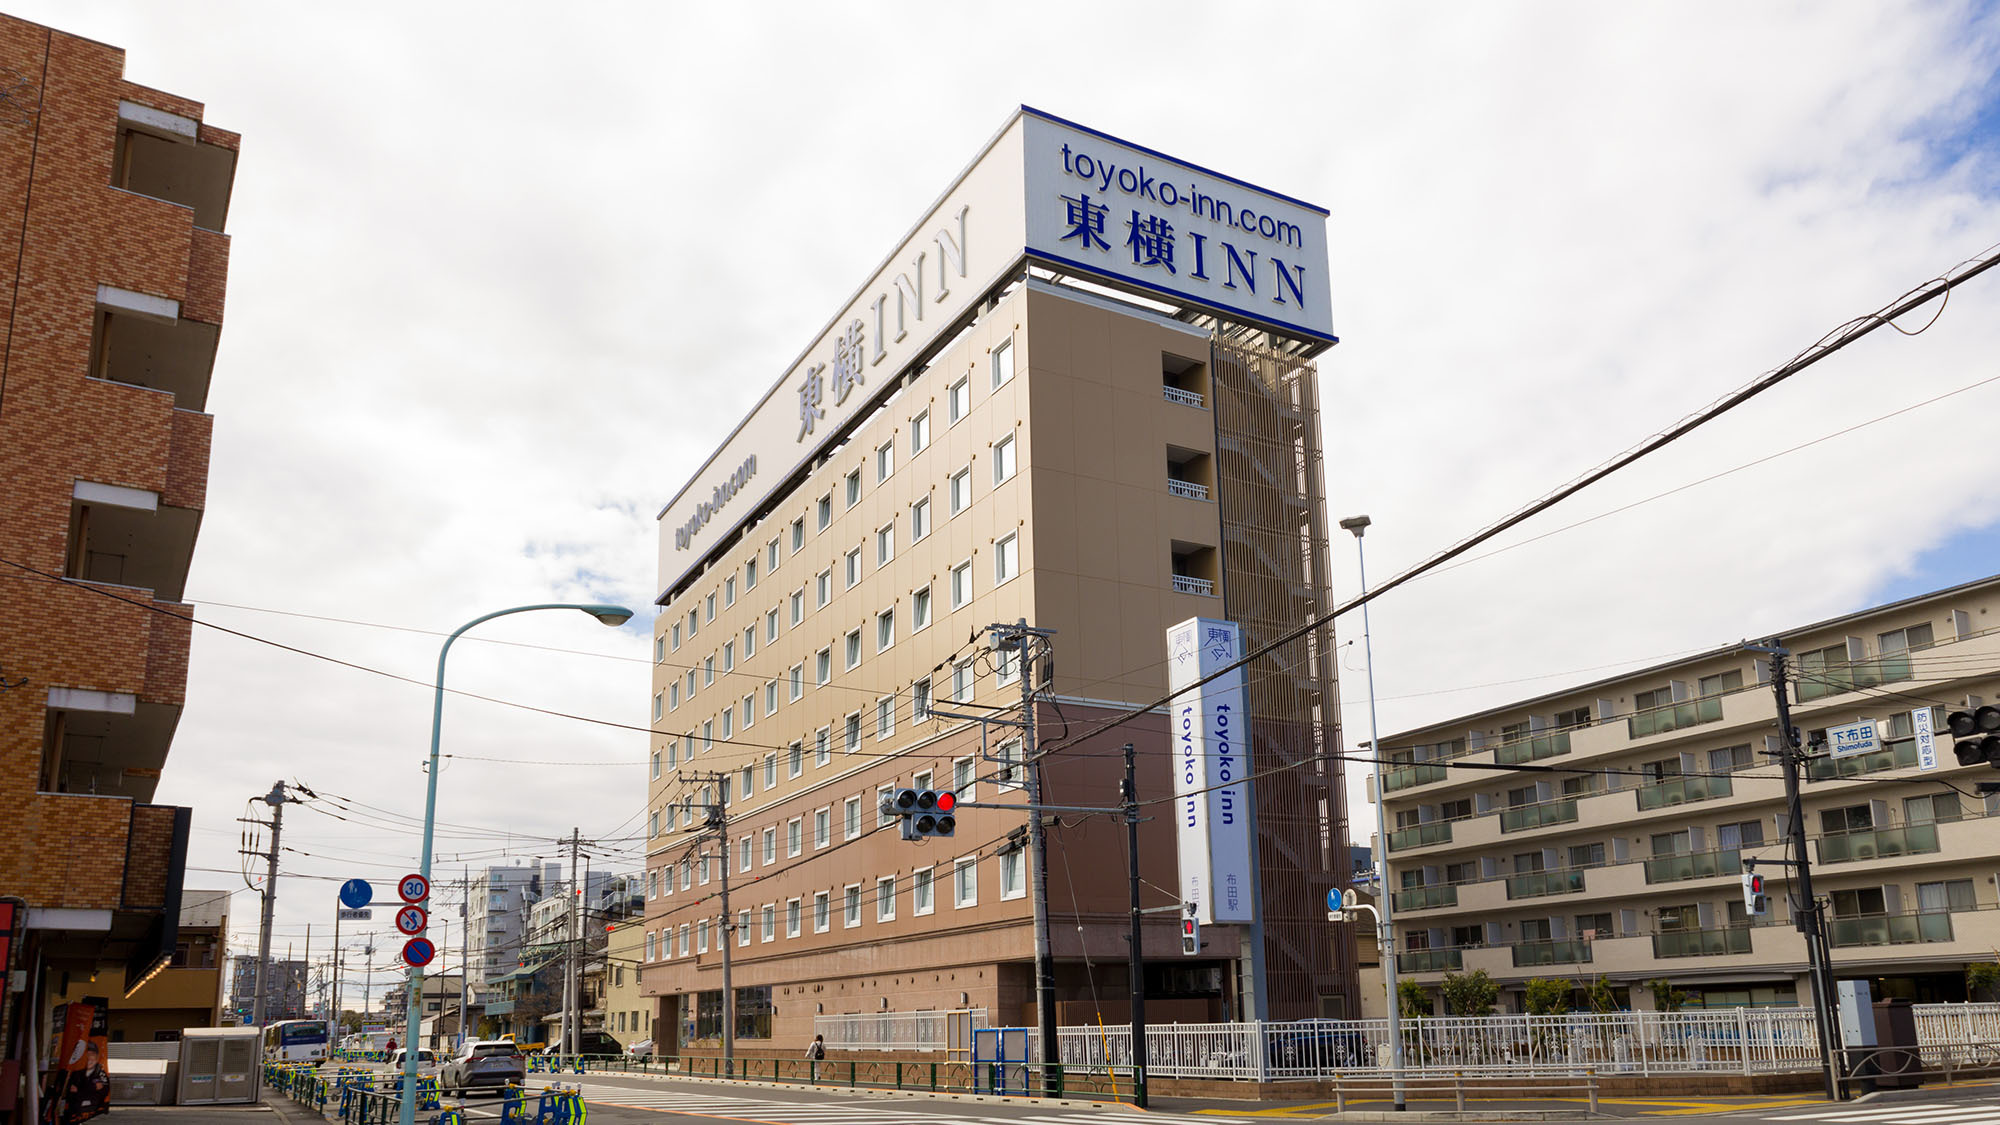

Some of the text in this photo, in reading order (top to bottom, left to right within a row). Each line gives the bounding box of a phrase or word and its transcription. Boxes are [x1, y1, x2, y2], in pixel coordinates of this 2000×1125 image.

[1060, 143, 1302, 248] toyoko-inn.com
[1059, 193, 1306, 310] 東横INN
[797, 204, 969, 443] 東横INN
[675, 454, 757, 551] toyoko-inn.com
[1181, 706, 1195, 785] toyoko
[1215, 704, 1236, 825] toyoko inn
[1833, 726, 1873, 744] 下布田
[1836, 741, 1873, 753] Shimofuda
[404, 882, 424, 896] 30
[1226, 873, 1239, 912] 布田駅
